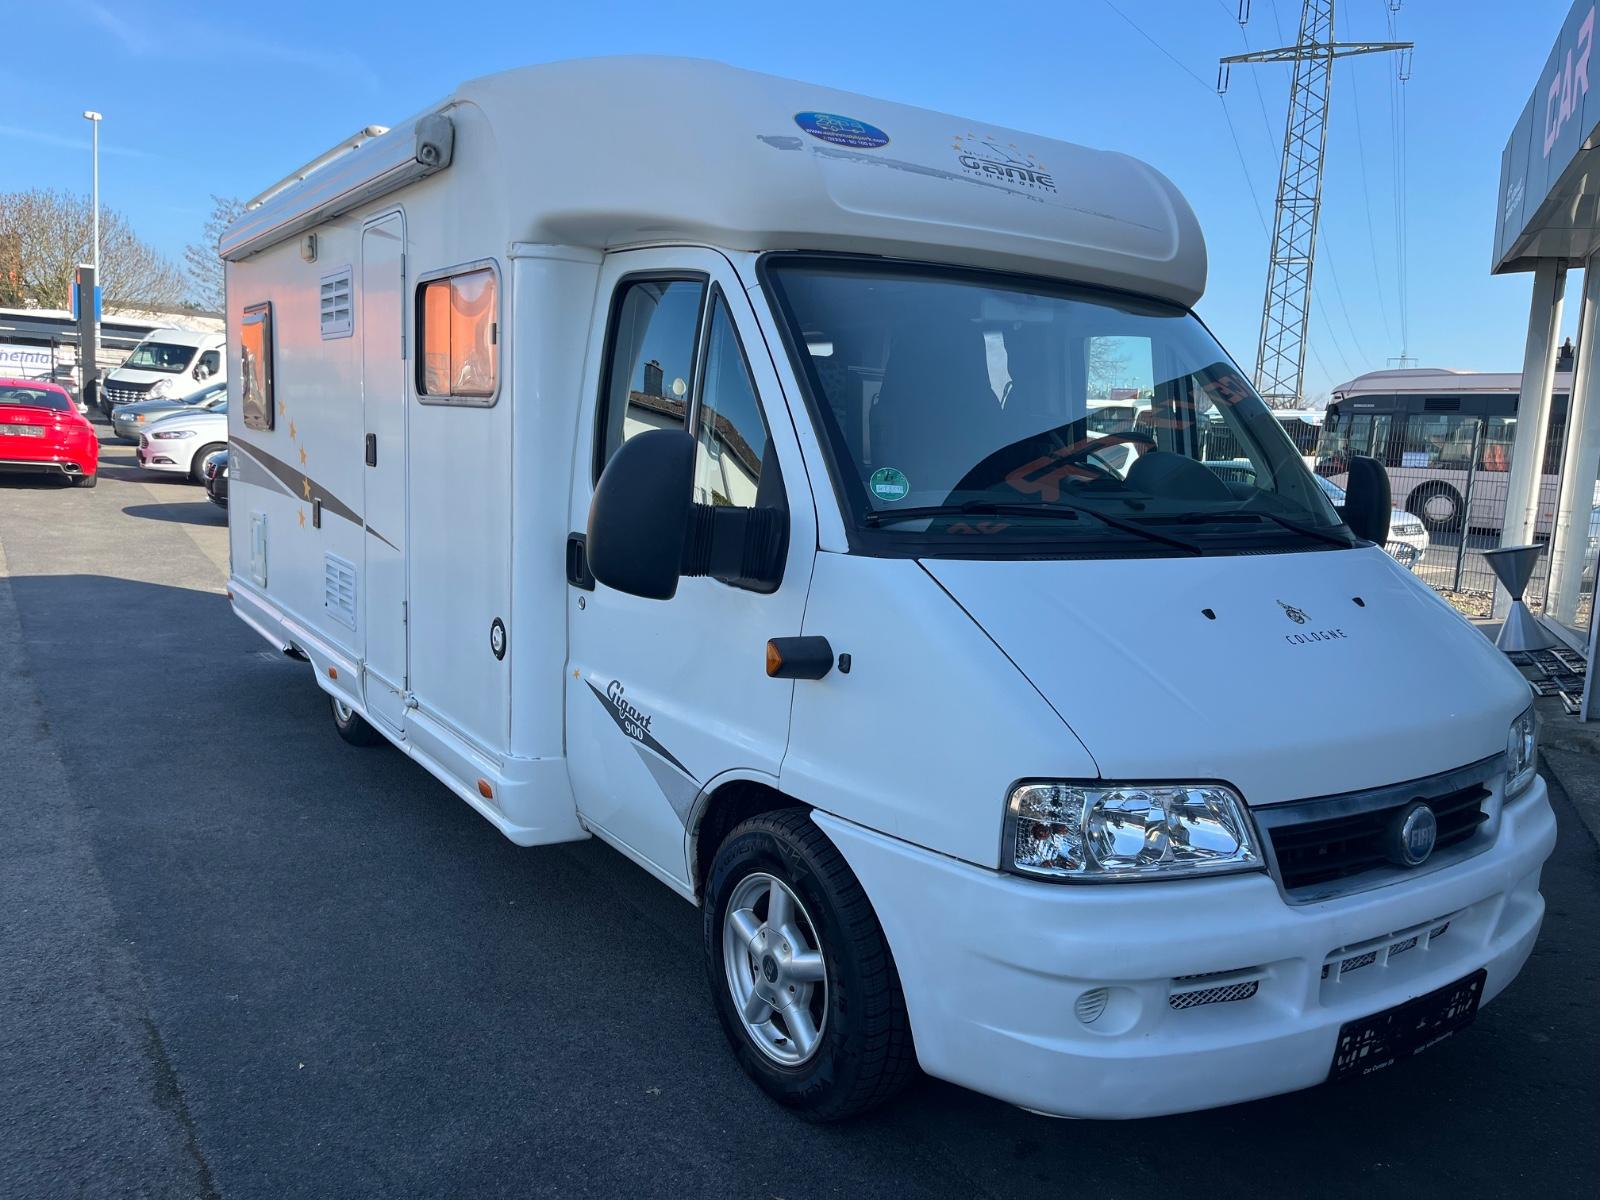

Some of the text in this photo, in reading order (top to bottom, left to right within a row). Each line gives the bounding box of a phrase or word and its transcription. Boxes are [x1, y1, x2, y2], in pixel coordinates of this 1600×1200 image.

[1543, 5, 1595, 159] CAR
[1285, 628, 1348, 646] COLOGNE
[606, 679, 652, 733] Gigant
[624, 720, 644, 740] 900
[1411, 825, 1433, 849] FIAT
